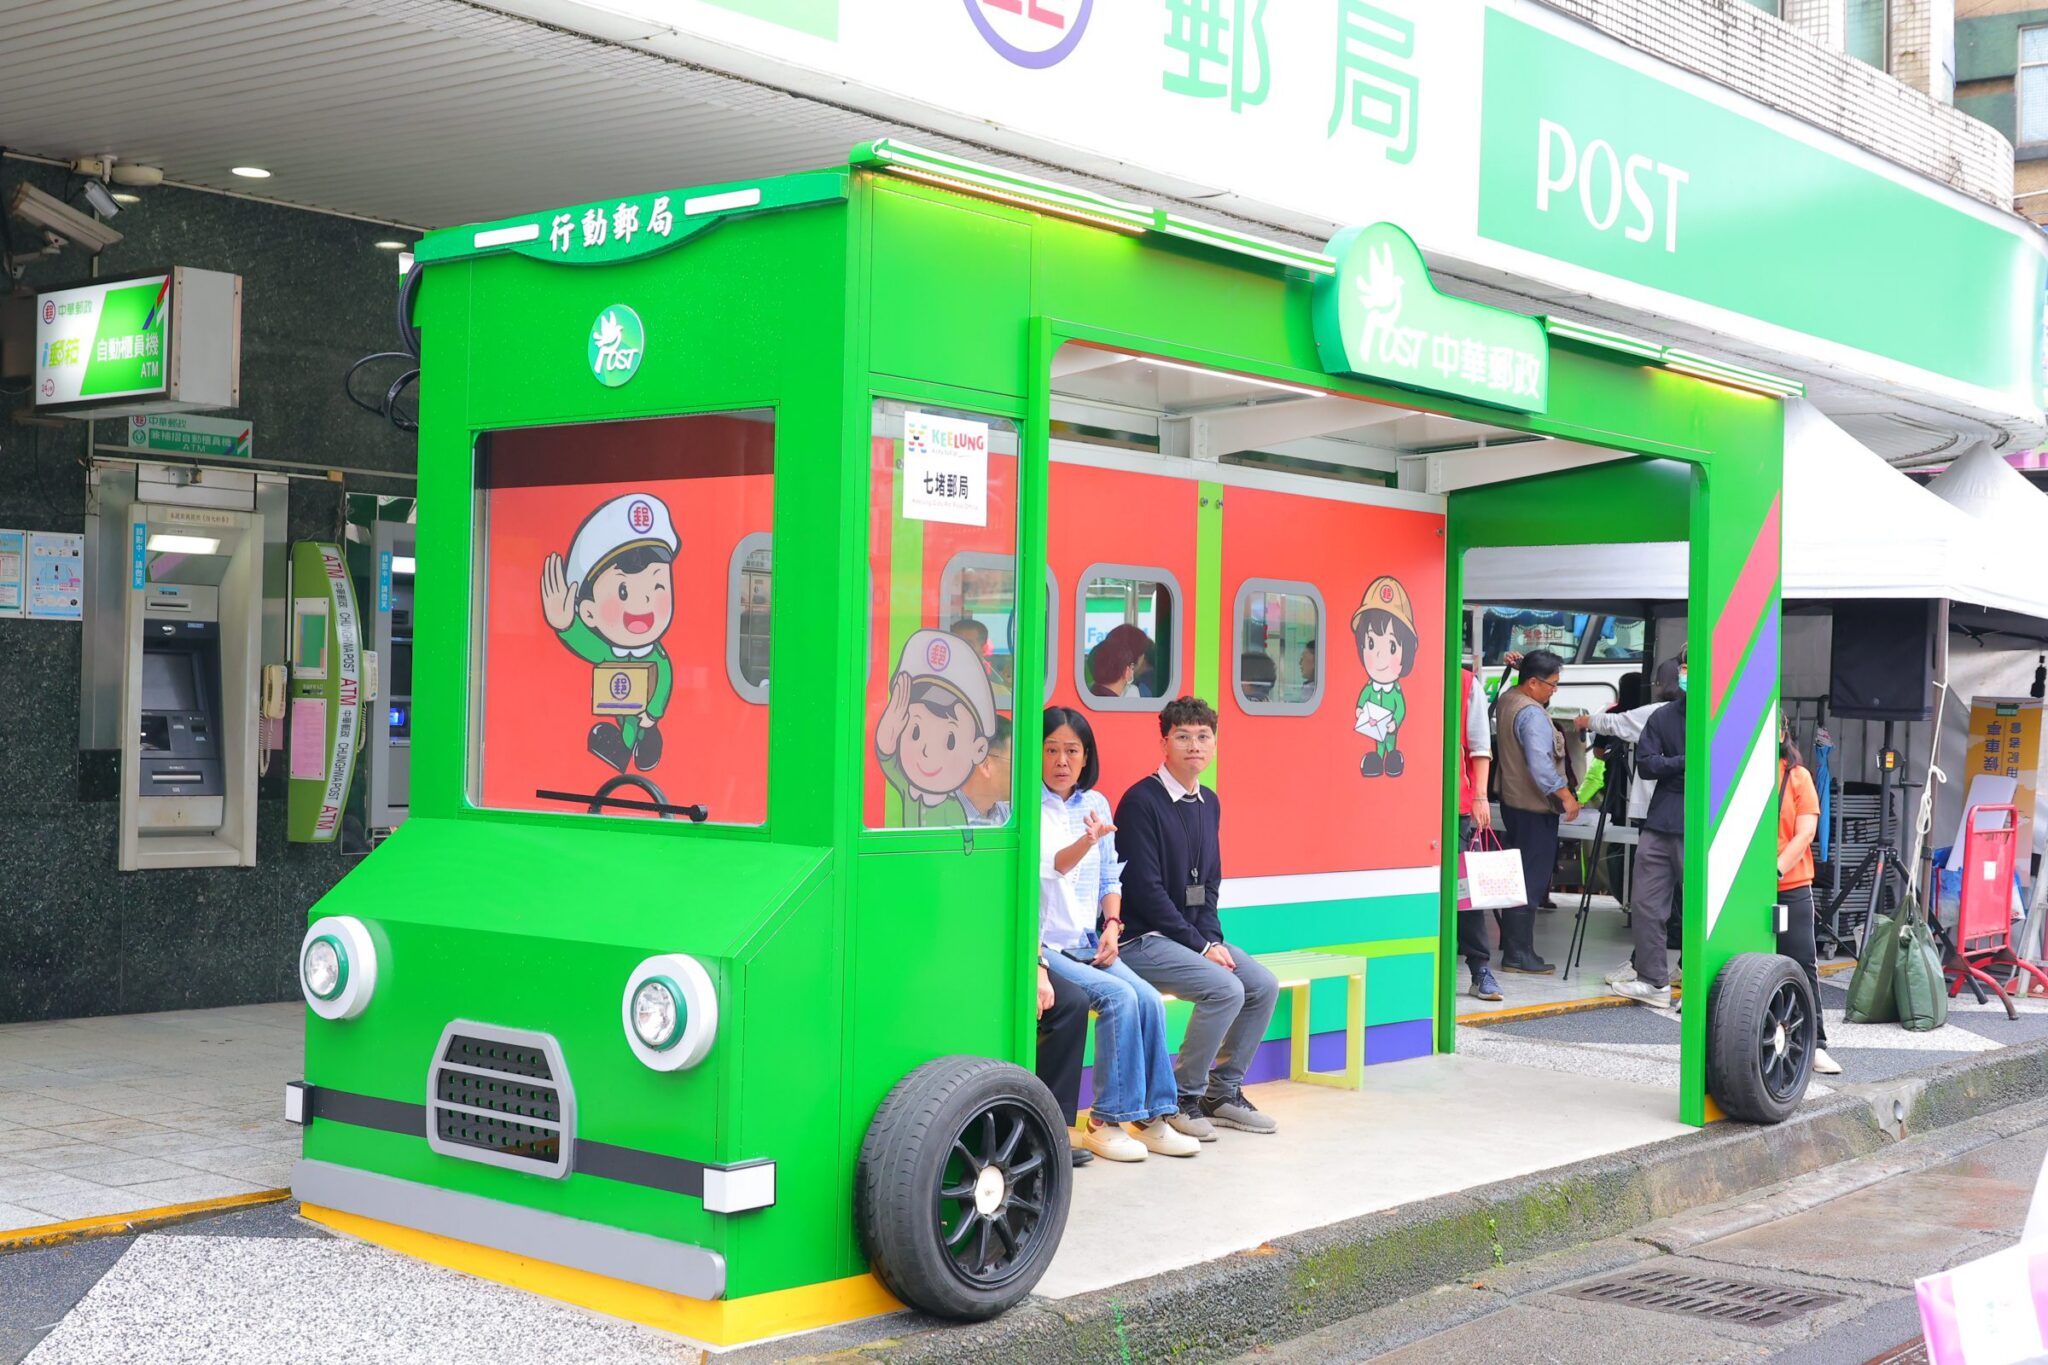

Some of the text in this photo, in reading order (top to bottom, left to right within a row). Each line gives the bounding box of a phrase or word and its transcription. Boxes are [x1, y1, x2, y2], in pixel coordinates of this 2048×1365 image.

[1162, 0, 1419, 165] 郵局
[1536, 117, 1690, 254] POST
[549, 195, 674, 254] 行動郵局
[58, 300, 93, 316] 中華郵政
[97, 333, 159, 362] 自動櫃員機
[140, 361, 159, 378] ATM
[1431, 331, 1541, 400] 中華郵政
[182, 443, 206, 453] ATM
[931, 429, 984, 451] KEELUNG
[923, 471, 969, 499] 七堵郵局
[321, 554, 345, 580] ATM
[340, 678, 358, 706] ATM
[316, 805, 338, 831] ATM
